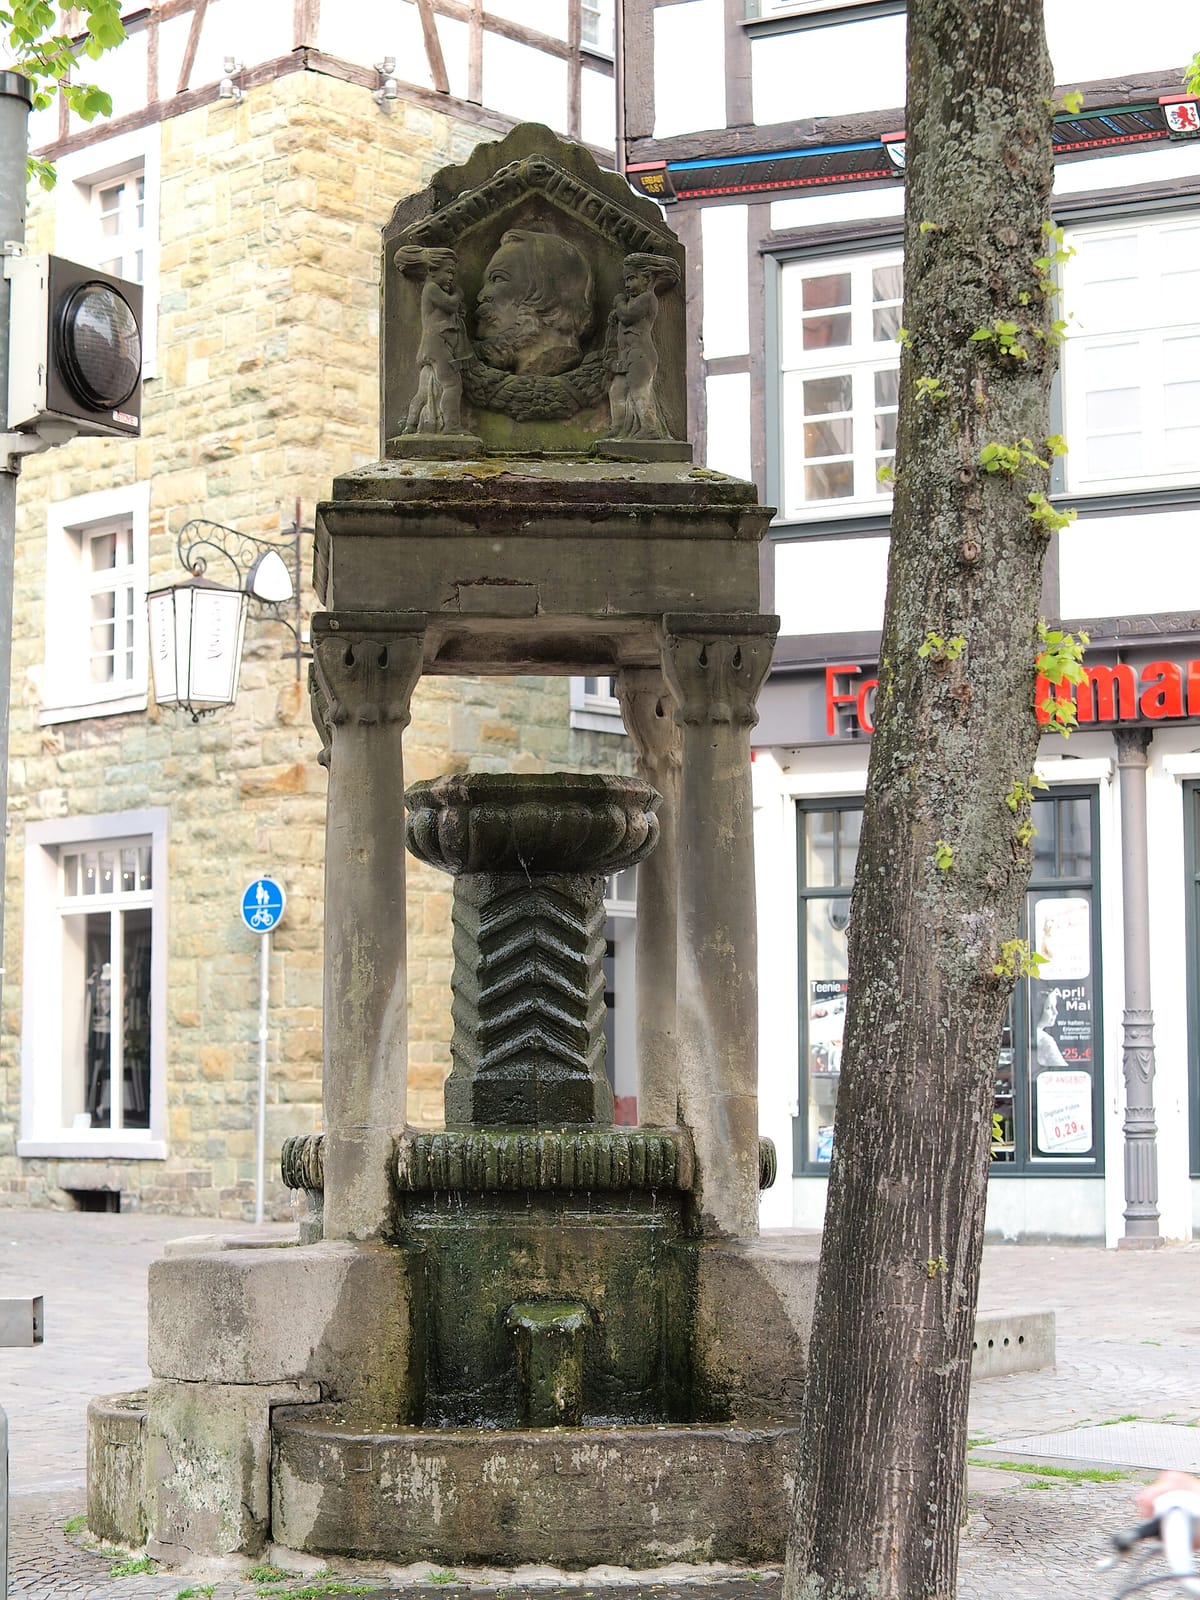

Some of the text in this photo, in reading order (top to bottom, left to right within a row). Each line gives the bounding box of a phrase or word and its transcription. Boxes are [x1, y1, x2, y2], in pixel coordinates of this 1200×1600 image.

[825, 665, 878, 736] Fo
[1053, 986, 1085, 1000] April
[1055, 1121, 1077, 1138] 0,29
